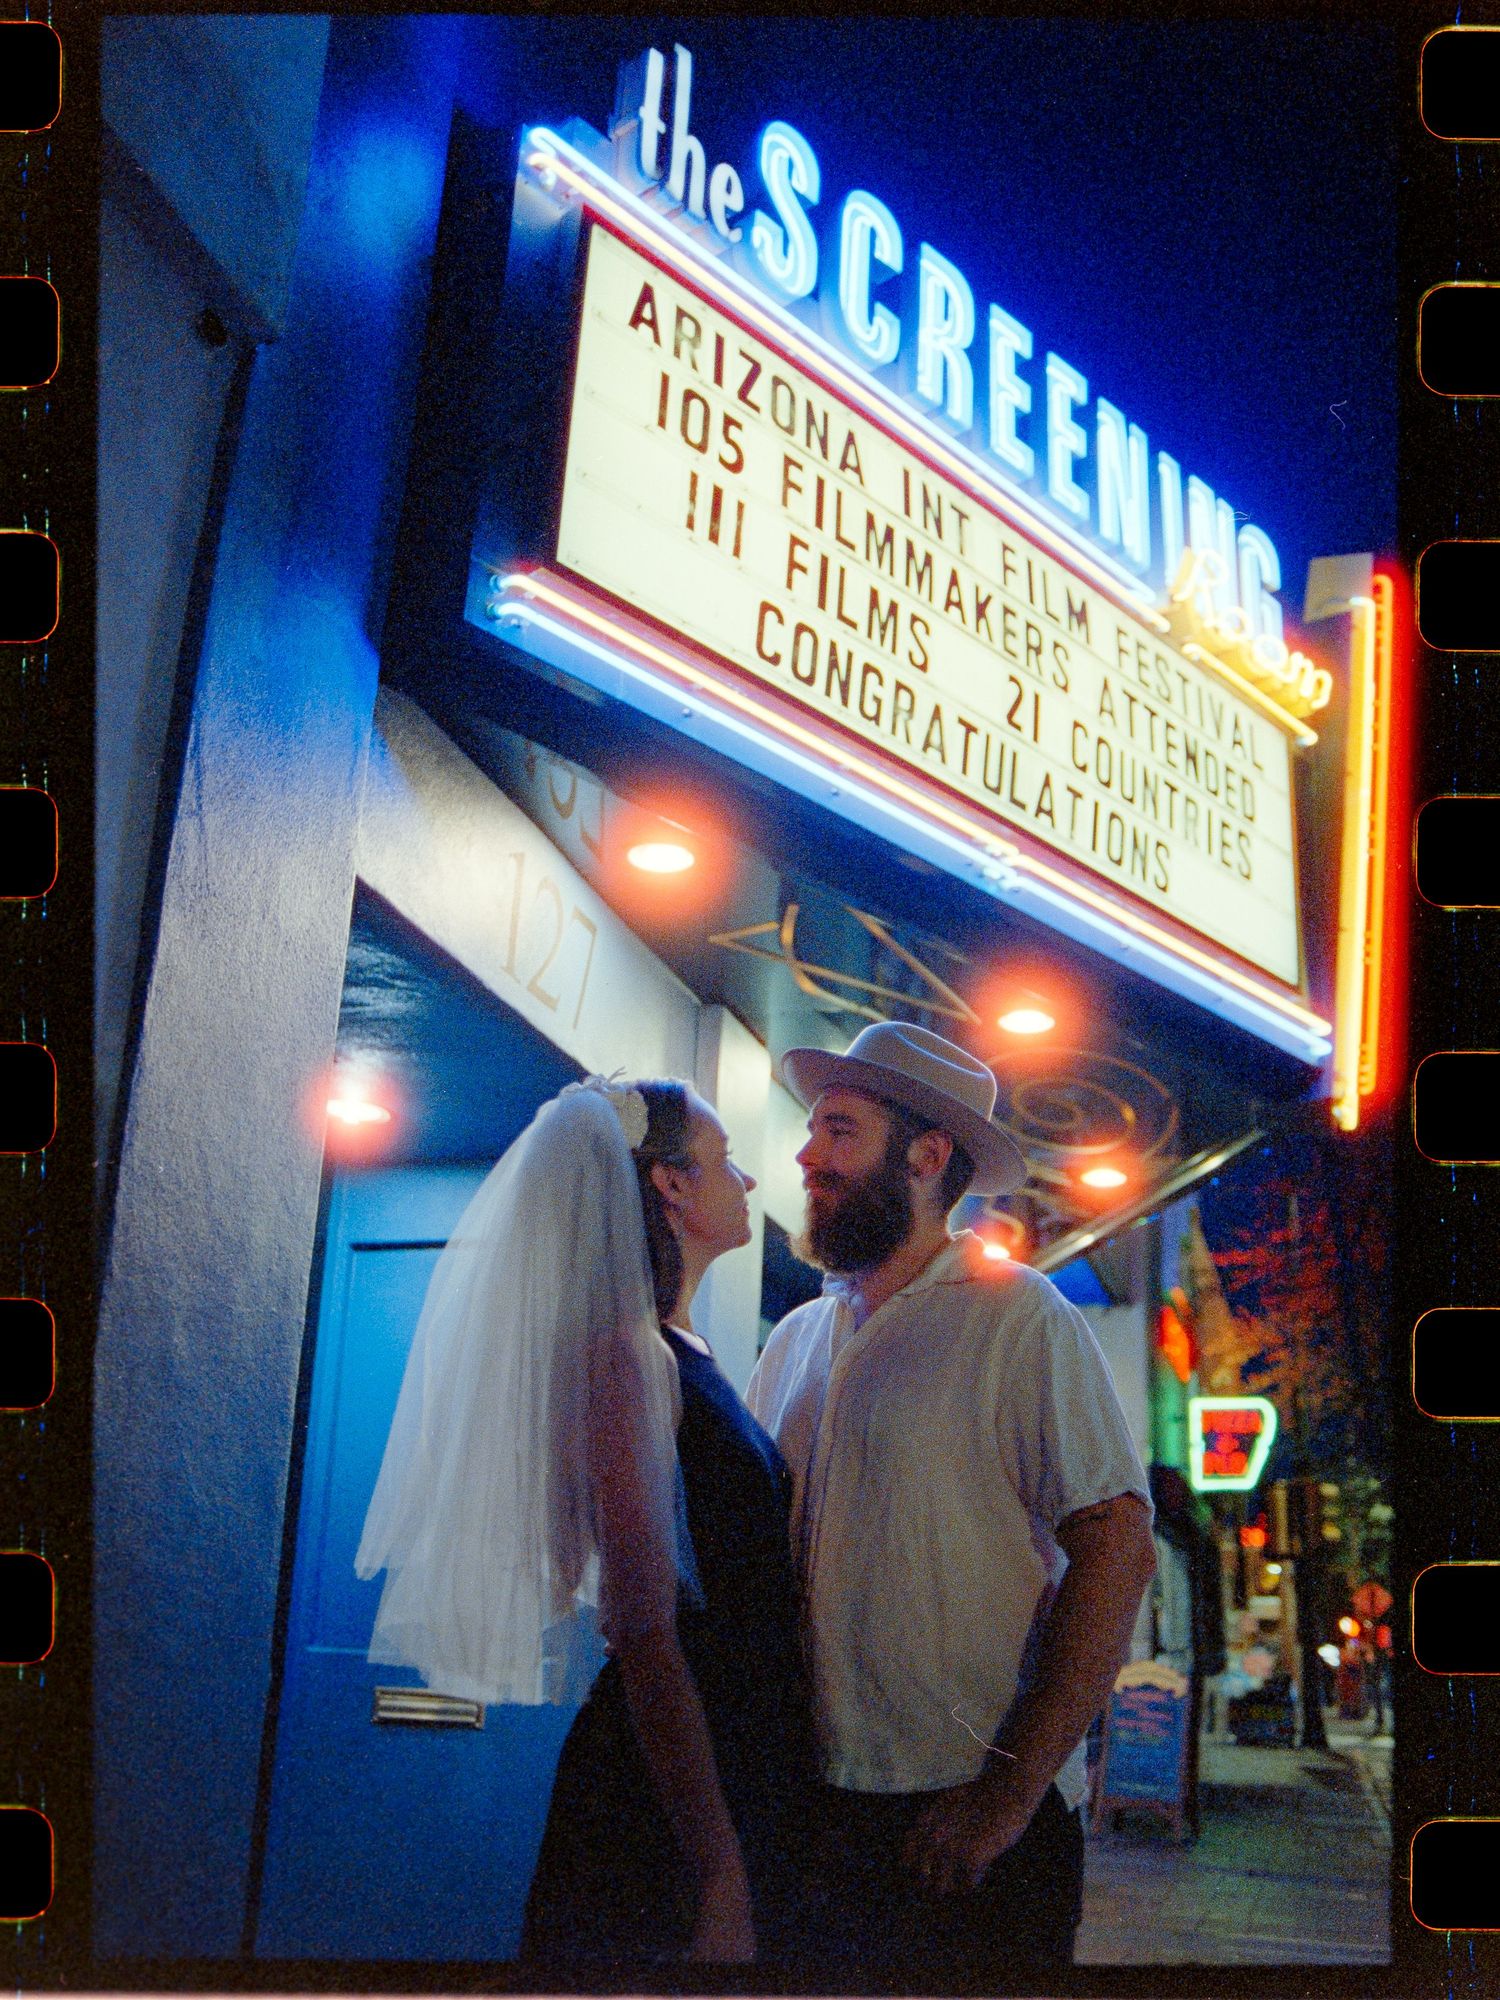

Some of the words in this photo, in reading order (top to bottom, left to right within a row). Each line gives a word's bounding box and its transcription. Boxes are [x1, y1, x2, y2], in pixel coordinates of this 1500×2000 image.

[627, 281, 866, 486] ARIZONA
[902, 467, 971, 556] INT
[1002, 542, 1091, 646] FILM
[1116, 627, 1265, 772] FESTIVAL
[638, 42, 746, 243] the
[751, 120, 1284, 645] SCREENING
[656, 370, 746, 475] 105
[780, 453, 1071, 694] FILMMAKERS
[1099, 677, 1256, 824] ATTENDED
[755, 600, 1171, 894] CONGRATULATIONS
[786, 532, 933, 675] FILMS
[1006, 673, 1040, 744] 21
[1071, 717, 1253, 882] COUNTRIES
[499, 852, 598, 1031] 127
